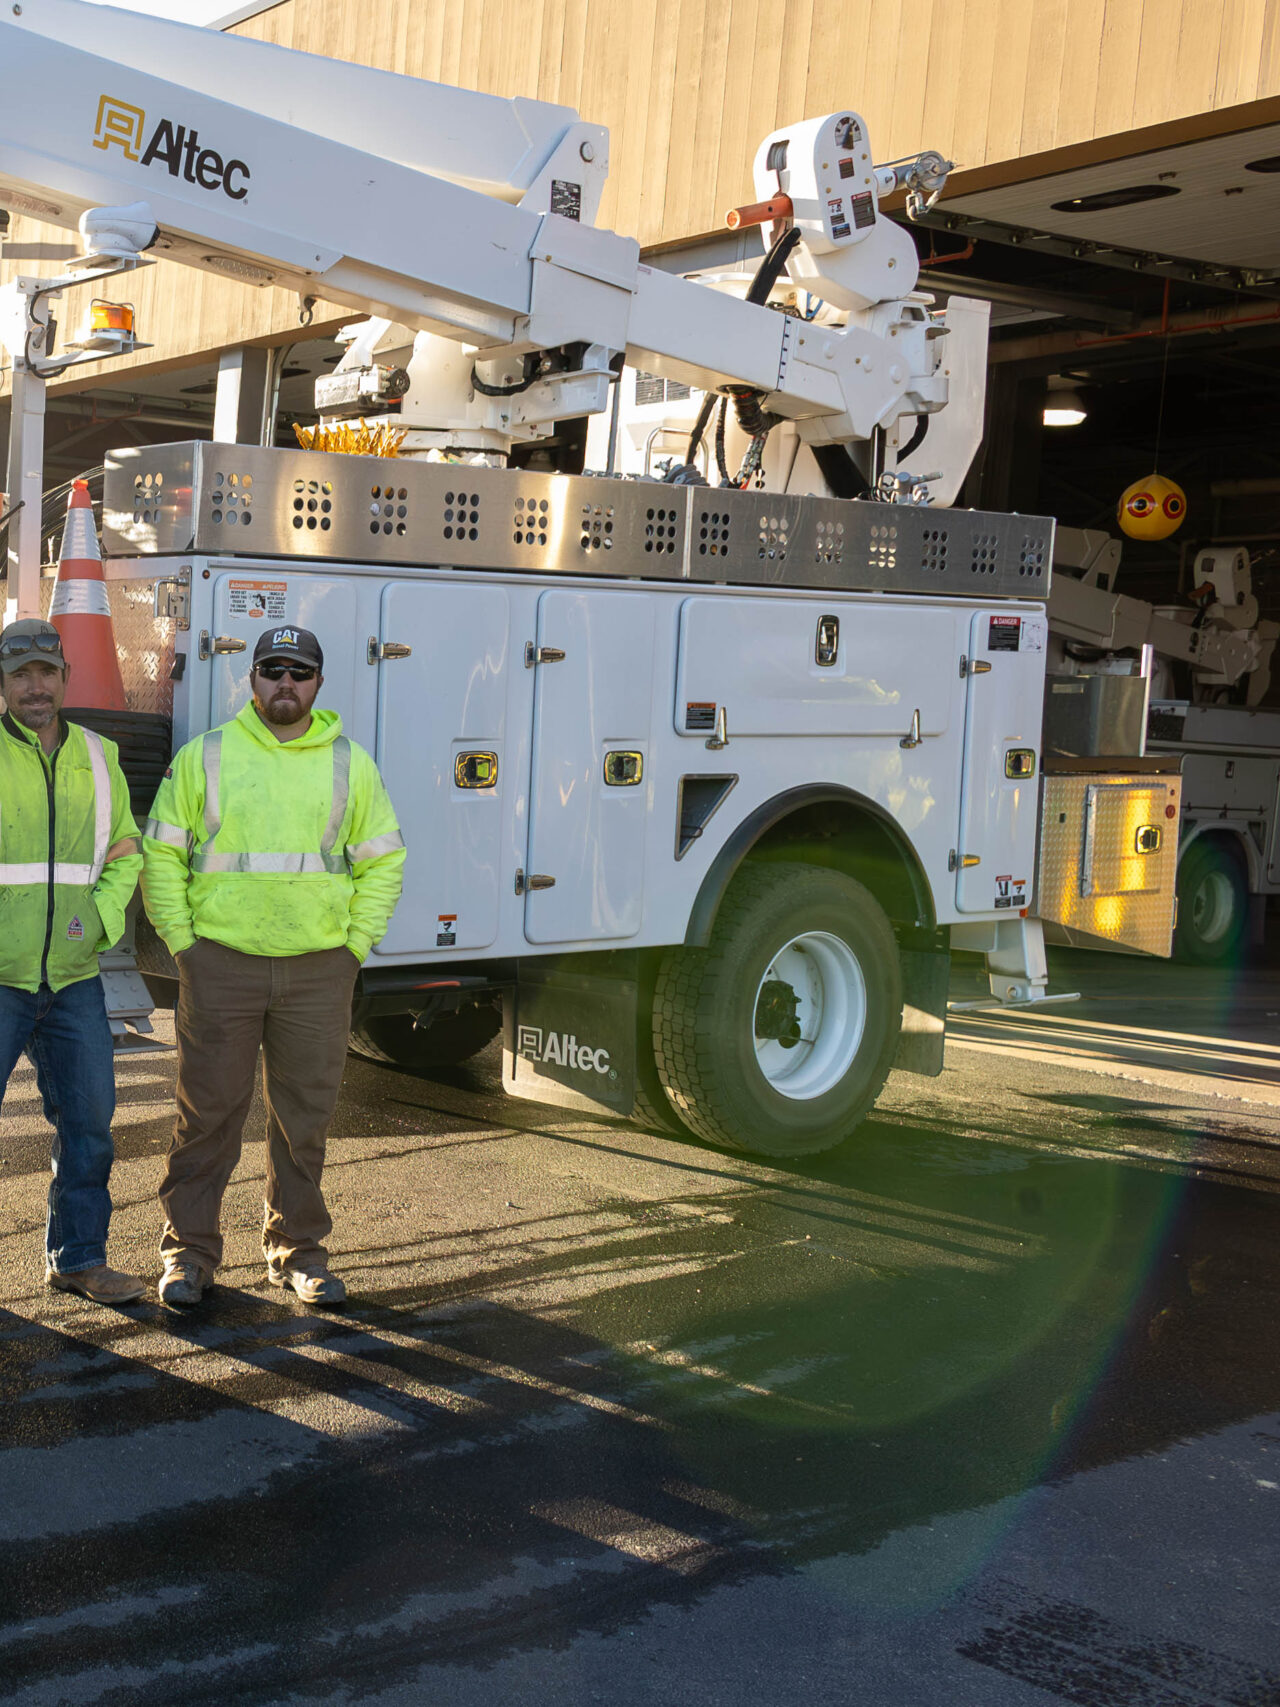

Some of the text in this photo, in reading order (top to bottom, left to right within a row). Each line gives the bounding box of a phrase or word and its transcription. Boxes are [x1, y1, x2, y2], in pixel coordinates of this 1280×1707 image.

[140, 118, 250, 200] Altec
[273, 629, 299, 644] CAT
[542, 1031, 611, 1074] Altec
